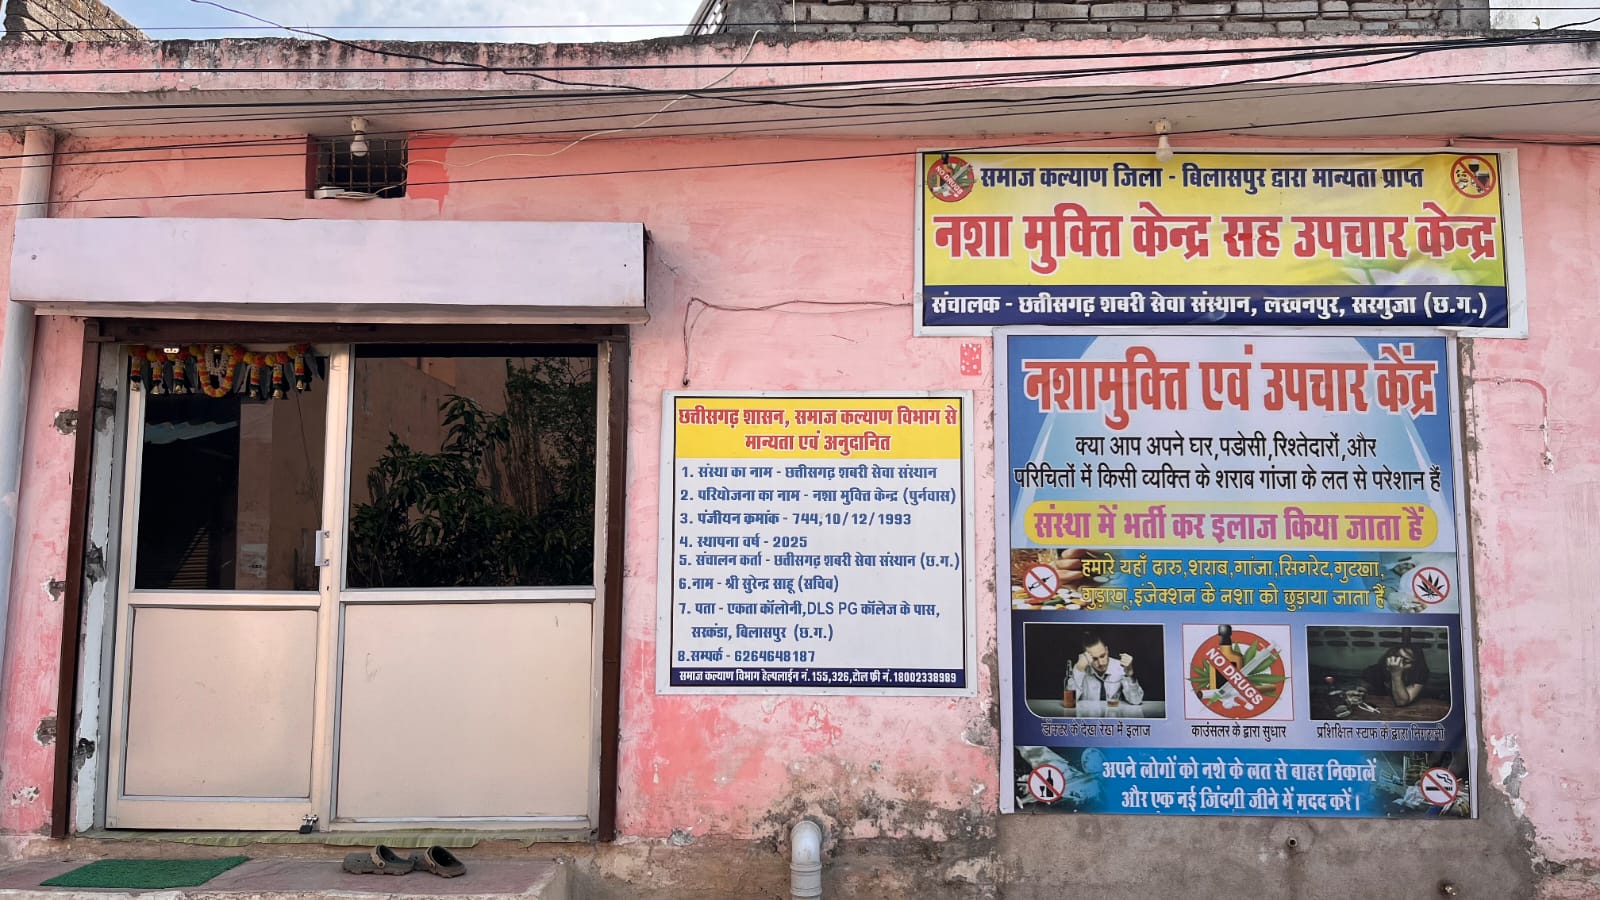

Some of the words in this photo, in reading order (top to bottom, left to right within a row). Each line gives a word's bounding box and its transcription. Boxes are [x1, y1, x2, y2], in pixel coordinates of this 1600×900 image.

[980, 168, 1035, 187] समाज
[1040, 168, 1108, 187] कल्याण
[1113, 163, 1163, 187] जिला
[1182, 163, 1266, 194] बिलासपुर
[1271, 168, 1307, 189] द्वारा
[1312, 168, 1377, 188] मान्यता
[1382, 168, 1424, 188] प्राप्त
[934, 216, 1013, 257] नशा
[1022, 202, 1123, 274] मुक्ति
[1131, 202, 1211, 259] केन्द्र
[1222, 217, 1283, 257] सह
[1291, 217, 1408, 257] उपचार
[1415, 201, 1496, 260] केन्द्र
[932, 291, 1001, 313] संचालक
[1019, 293, 1095, 317] छत्तीसगढ़
[1100, 292, 1145, 313] शबरी
[1151, 292, 1186, 313] सेवा
[1191, 291, 1257, 317] संस्थान,
[1264, 297, 1346, 318] लखनपुर,
[1352, 297, 1416, 319] सरगुजा
[1424, 291, 1487, 318] (छ.ग.)
[1025, 346, 1190, 430] नशामुक्ति
[1199, 344, 1253, 411] एवं
[1261, 362, 1368, 411] उपचार
[1374, 345, 1435, 416] केंद्र
[679, 405, 739, 428] छत्तीसगढ़
[743, 409, 789, 428] शासन,
[795, 410, 837, 425] समाज
[840, 410, 894, 424] कल्याण
[897, 405, 940, 424] विभाग
[944, 405, 957, 424] से
[745, 435, 794, 450] मान्यता
[799, 430, 820, 450] एवं
[824, 431, 891, 456] अनुदानित
[1075, 437, 1105, 456] क्या
[1110, 437, 1141, 456] आप
[1147, 431, 1184, 456] अपने
[682, 467, 694, 478] 1.
[698, 463, 728, 478] संस्था
[731, 467, 747, 478] का
[750, 467, 773, 478] नाम
[785, 464, 835, 481] छत्तीसगढ़
[839, 464, 868, 479] शबरी
[872, 464, 894, 479] सेवा
[898, 464, 938, 479] संस्थान
[1014, 462, 1076, 488] परिचितों
[1081, 463, 1092, 488] में
[1097, 463, 1137, 488] किसी
[1142, 463, 1190, 488] व्यक्ति
[1195, 463, 1210, 488] के
[1216, 470, 1255, 489] शराब
[1260, 465, 1297, 489] गांजा
[1302, 464, 1316, 489] के
[1321, 471, 1348, 490] लत
[1353, 464, 1367, 490] से
[1372, 464, 1425, 490] परेशान
[1430, 464, 1440, 491] हैं
[680, 490, 694, 501] 2.
[698, 487, 756, 501] परियोजना
[758, 490, 774, 501] का
[777, 490, 800, 501] नाम
[813, 490, 837, 501] नशा
[840, 487, 871, 505] मुक्ति
[874, 487, 899, 502] केन्द्र
[903, 487, 956, 506] (पुर्नवास)
[680, 513, 693, 524] 3.
[698, 509, 741, 524] पंजीयन
[1034, 504, 1091, 539] संस्था
[1097, 505, 1118, 538] में
[1124, 505, 1166, 538] भर्ती
[1171, 514, 1205, 539] कर
[1211, 514, 1278, 543] इलाज
[1284, 506, 1339, 540] किया
[1344, 515, 1401, 540] जाता
[1402, 507, 1424, 541] हैं
[680, 536, 693, 547] 4.
[697, 536, 739, 548] स्थापना
[743, 533, 760, 547] वर्ष
[773, 536, 807, 548] 2025
[679, 555, 692, 566] 5.
[696, 551, 737, 566] संचालन
[740, 551, 762, 566] कर्ता
[774, 552, 820, 569] छत्तीसगढ़
[824, 552, 851, 566] शबरी
[855, 552, 876, 566] सेवा
[880, 552, 916, 566] संस्थान
[920, 552, 960, 570] (छ.ग.)
[1081, 553, 1115, 577] हमारे
[1120, 553, 1147, 577] यहाँ
[725, 575, 739, 589] श्री
[742, 575, 770, 593] सुरेन्द्र
[773, 578, 795, 594] साहू
[798, 575, 839, 592] (सचिव)
[1201, 582, 1215, 604] के
[1221, 588, 1254, 605] नशा
[1259, 583, 1279, 605] को
[1333, 590, 1370, 605] जाता
[1373, 583, 1385, 608] हैं
[678, 603, 691, 614] 7.
[695, 603, 716, 614] पता
[727, 603, 757, 614] एकता
[839, 602, 857, 615] PG
[860, 601, 897, 615] कॉलेज
[900, 601, 910, 615] के
[914, 604, 940, 618] पास,
[691, 623, 732, 640] सरकंडा,
[736, 624, 787, 642] बिलासपुर
[794, 624, 833, 641] (छ.ग.)
[734, 650, 815, 662] 6264648187
[680, 671, 703, 681] समाज
[705, 671, 734, 681] कल्याण
[736, 669, 760, 681] विभाग
[762, 669, 799, 682] हेल्पलाईन
[1206, 648, 1226, 667] NO
[1223, 665, 1263, 705] DRUGS
[1070, 719, 1079, 736] के
[1126, 725, 1151, 738] इलाज
[1191, 722, 1230, 737] काउंसलर
[1232, 722, 1240, 737] के
[1242, 726, 1260, 738] द्वारा
[1262, 726, 1286, 742] सुधार
[1317, 723, 1353, 738] प्रशिक्षित
[1356, 727, 1377, 738] स्टाफ
[1380, 721, 1389, 739] के
[1102, 756, 1137, 778] अपने
[1139, 755, 1177, 778] लोगों
[1177, 756, 1199, 779] को
[1201, 757, 1226, 779] नशे
[1228, 757, 1244, 779] के
[1246, 763, 1272, 780] लत
[1274, 758, 1288, 780] से
[1290, 764, 1324, 780] बाहर
[1326, 758, 1376, 781] निकालें
[1122, 785, 1148, 808] और
[1150, 792, 1175, 808] एक
[1177, 785, 1196, 811] नई
[1199, 785, 1245, 809] जिंदगी
[1247, 787, 1279, 809] जीने
[1282, 786, 1294, 810] में
[1296, 794, 1327, 810] मदद
